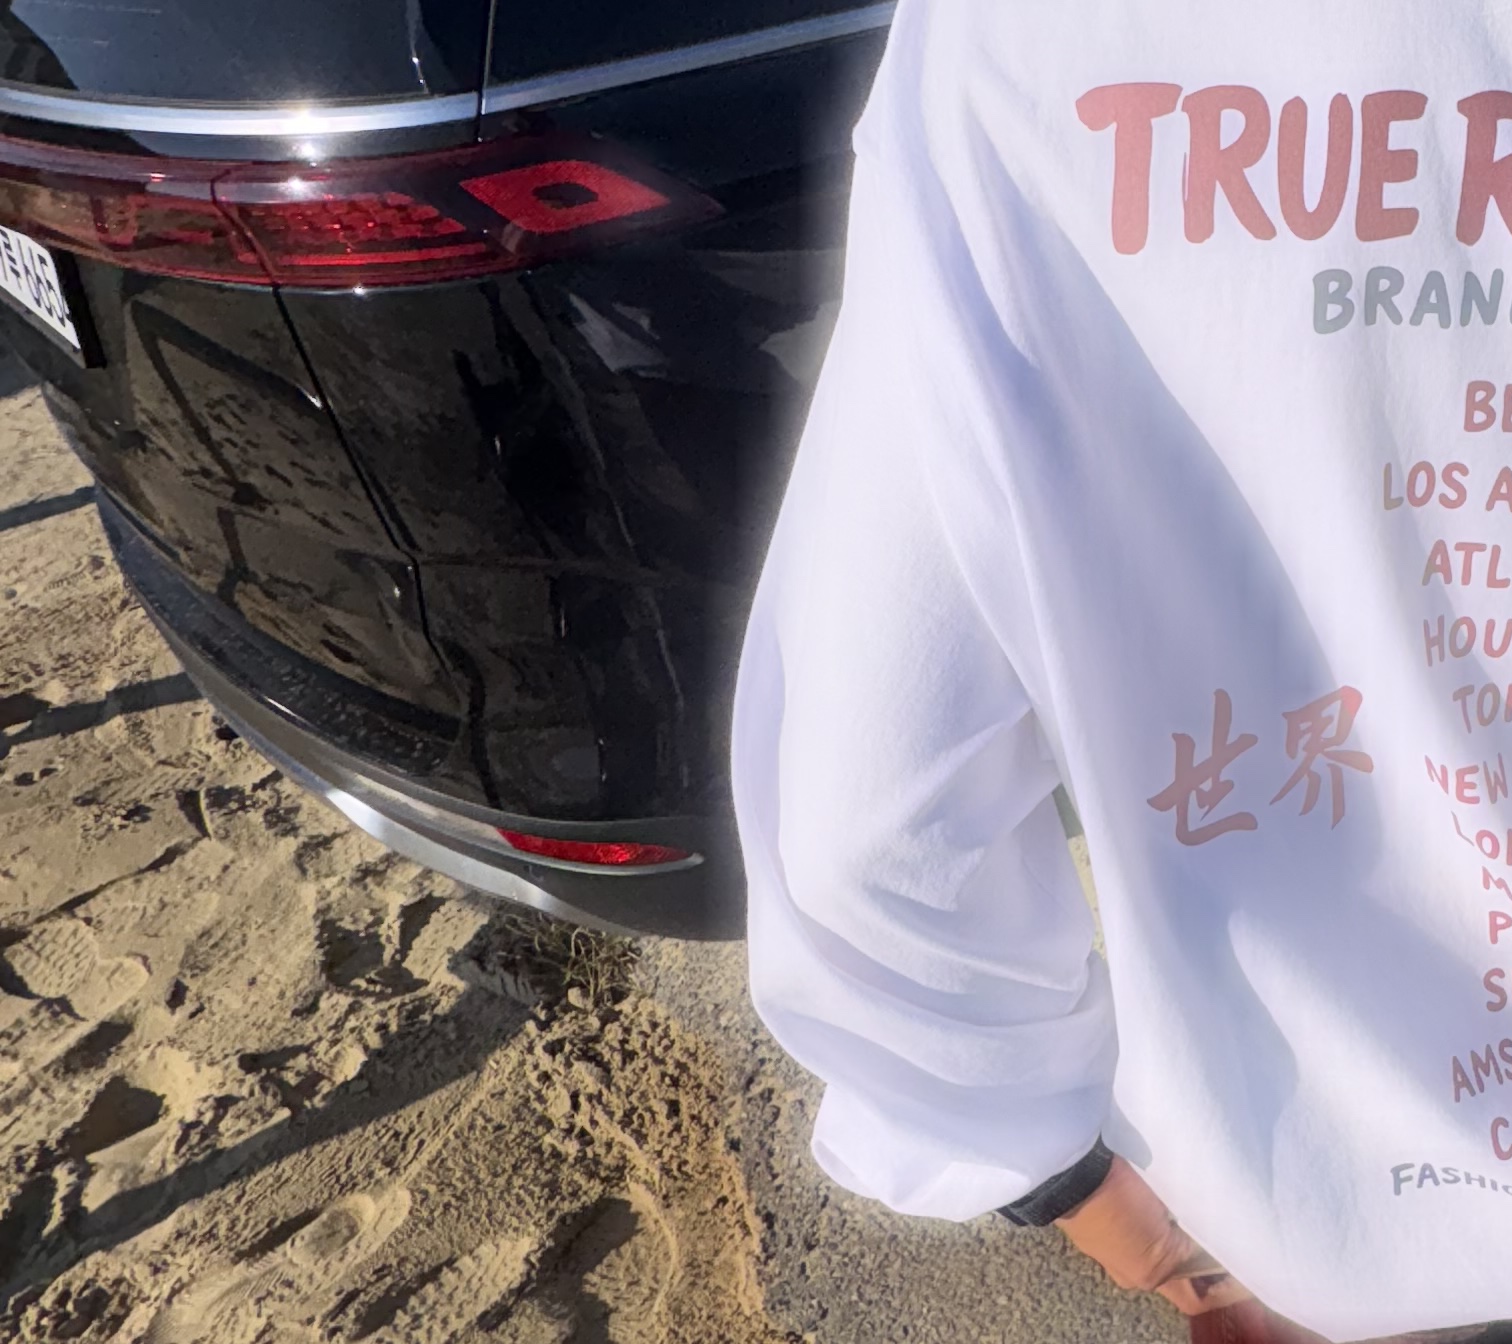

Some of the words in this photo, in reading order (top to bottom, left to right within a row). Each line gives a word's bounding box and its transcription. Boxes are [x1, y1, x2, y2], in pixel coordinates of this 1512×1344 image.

[1075, 82, 1428, 256] TRUE
[1383, 461, 1470, 511] LOS
[1146, 684, 1374, 847] 世界
[1425, 752, 1508, 805] NEW
